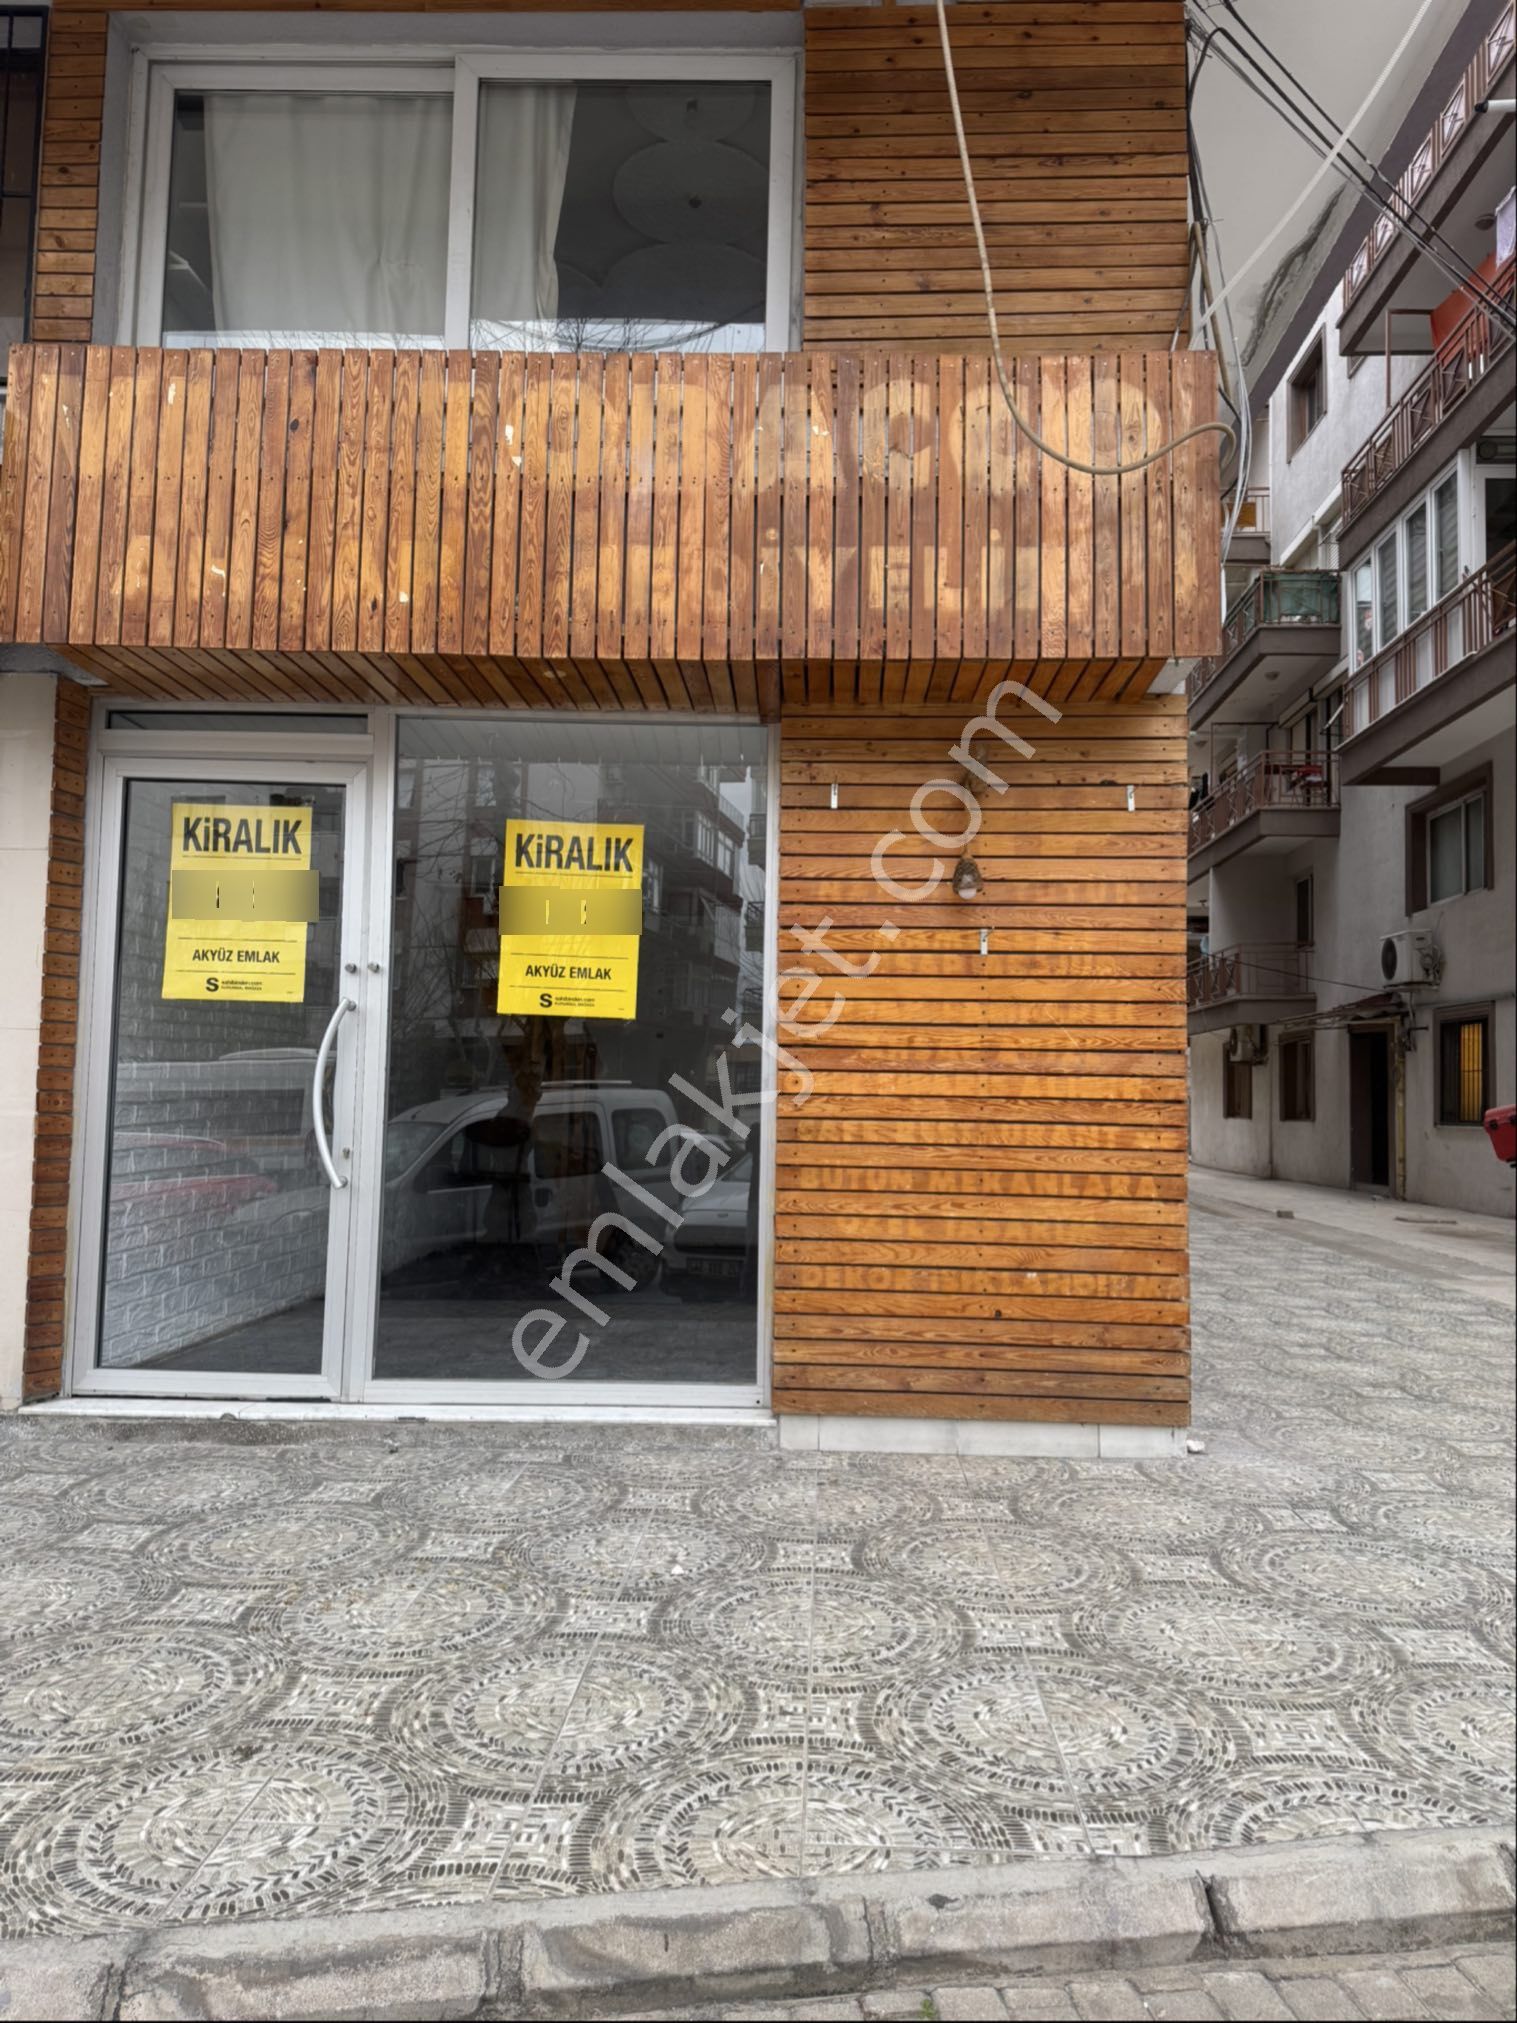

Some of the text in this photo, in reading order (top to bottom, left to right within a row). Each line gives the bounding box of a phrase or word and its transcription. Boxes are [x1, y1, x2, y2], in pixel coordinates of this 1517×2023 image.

[192, 946, 280, 964] AKYÜZ EMLAK
[525, 963, 611, 981] AKYÜZ EMLAK
[206, 977, 219, 992] S
[539, 993, 553, 1008] S
